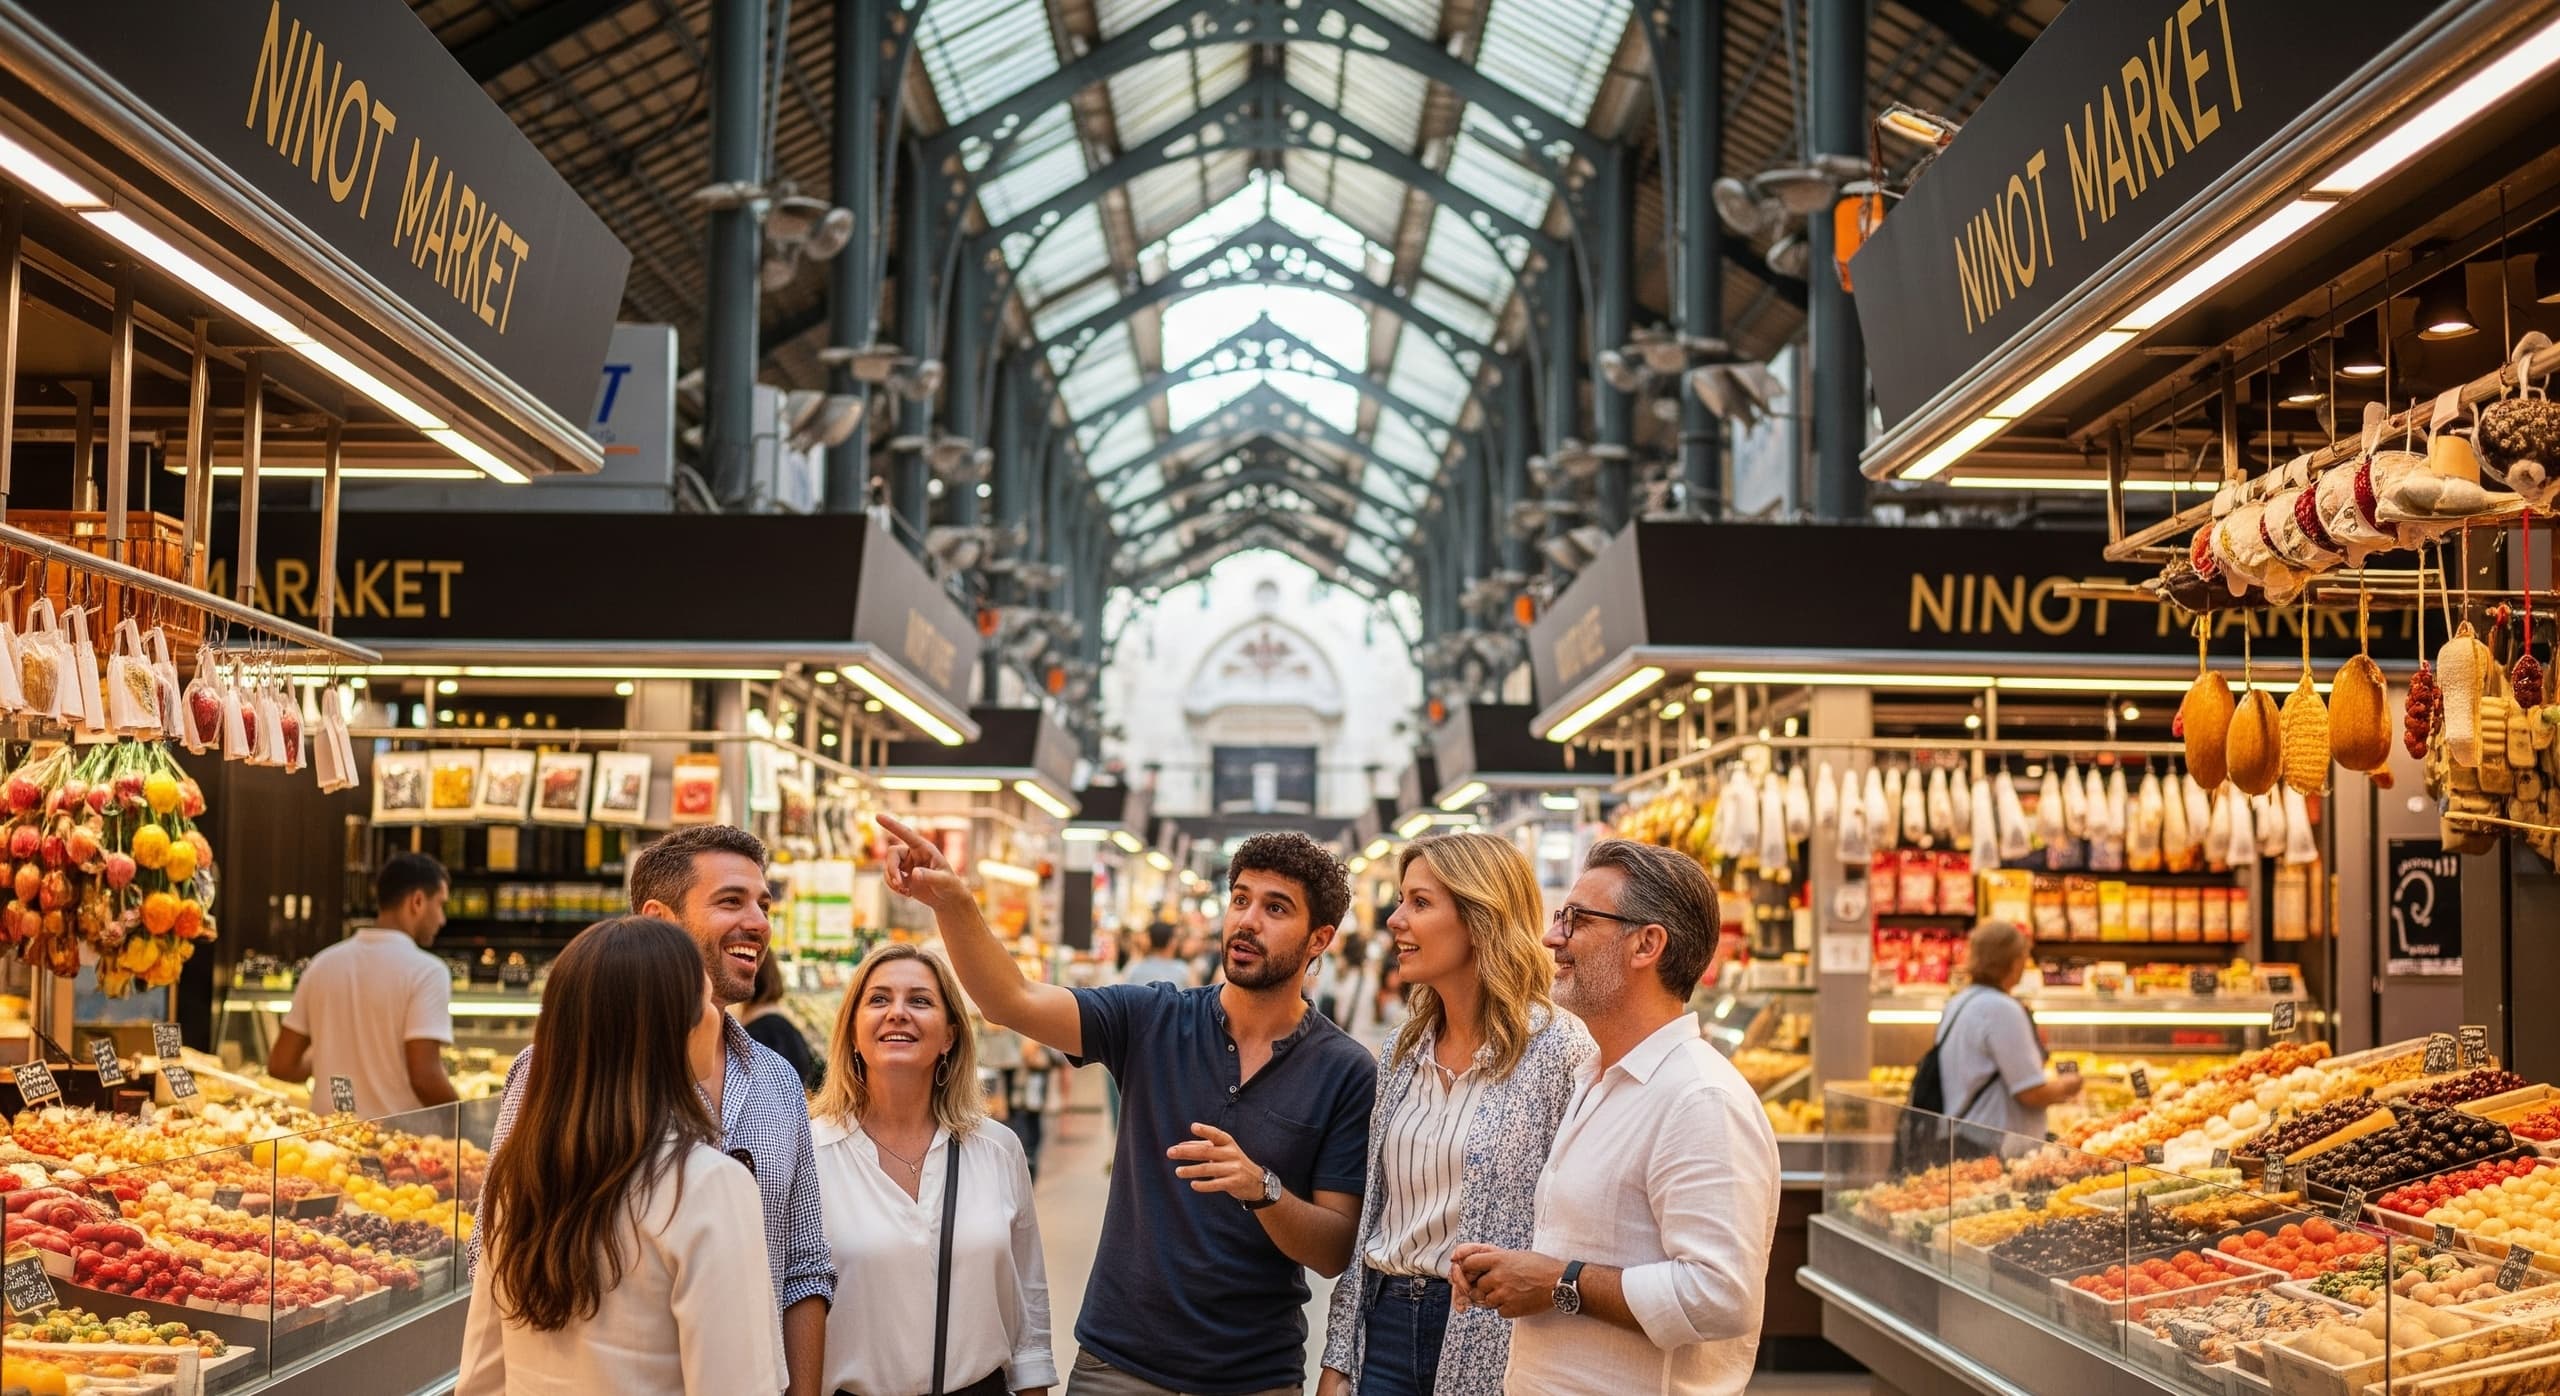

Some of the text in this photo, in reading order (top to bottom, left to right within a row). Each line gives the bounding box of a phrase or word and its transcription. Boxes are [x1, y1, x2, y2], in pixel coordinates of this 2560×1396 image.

[246, 0, 529, 334] NINOT MARKET
[1954, 0, 2242, 334] NINOT MARKET
[1909, 573, 2127, 637] NINOT
